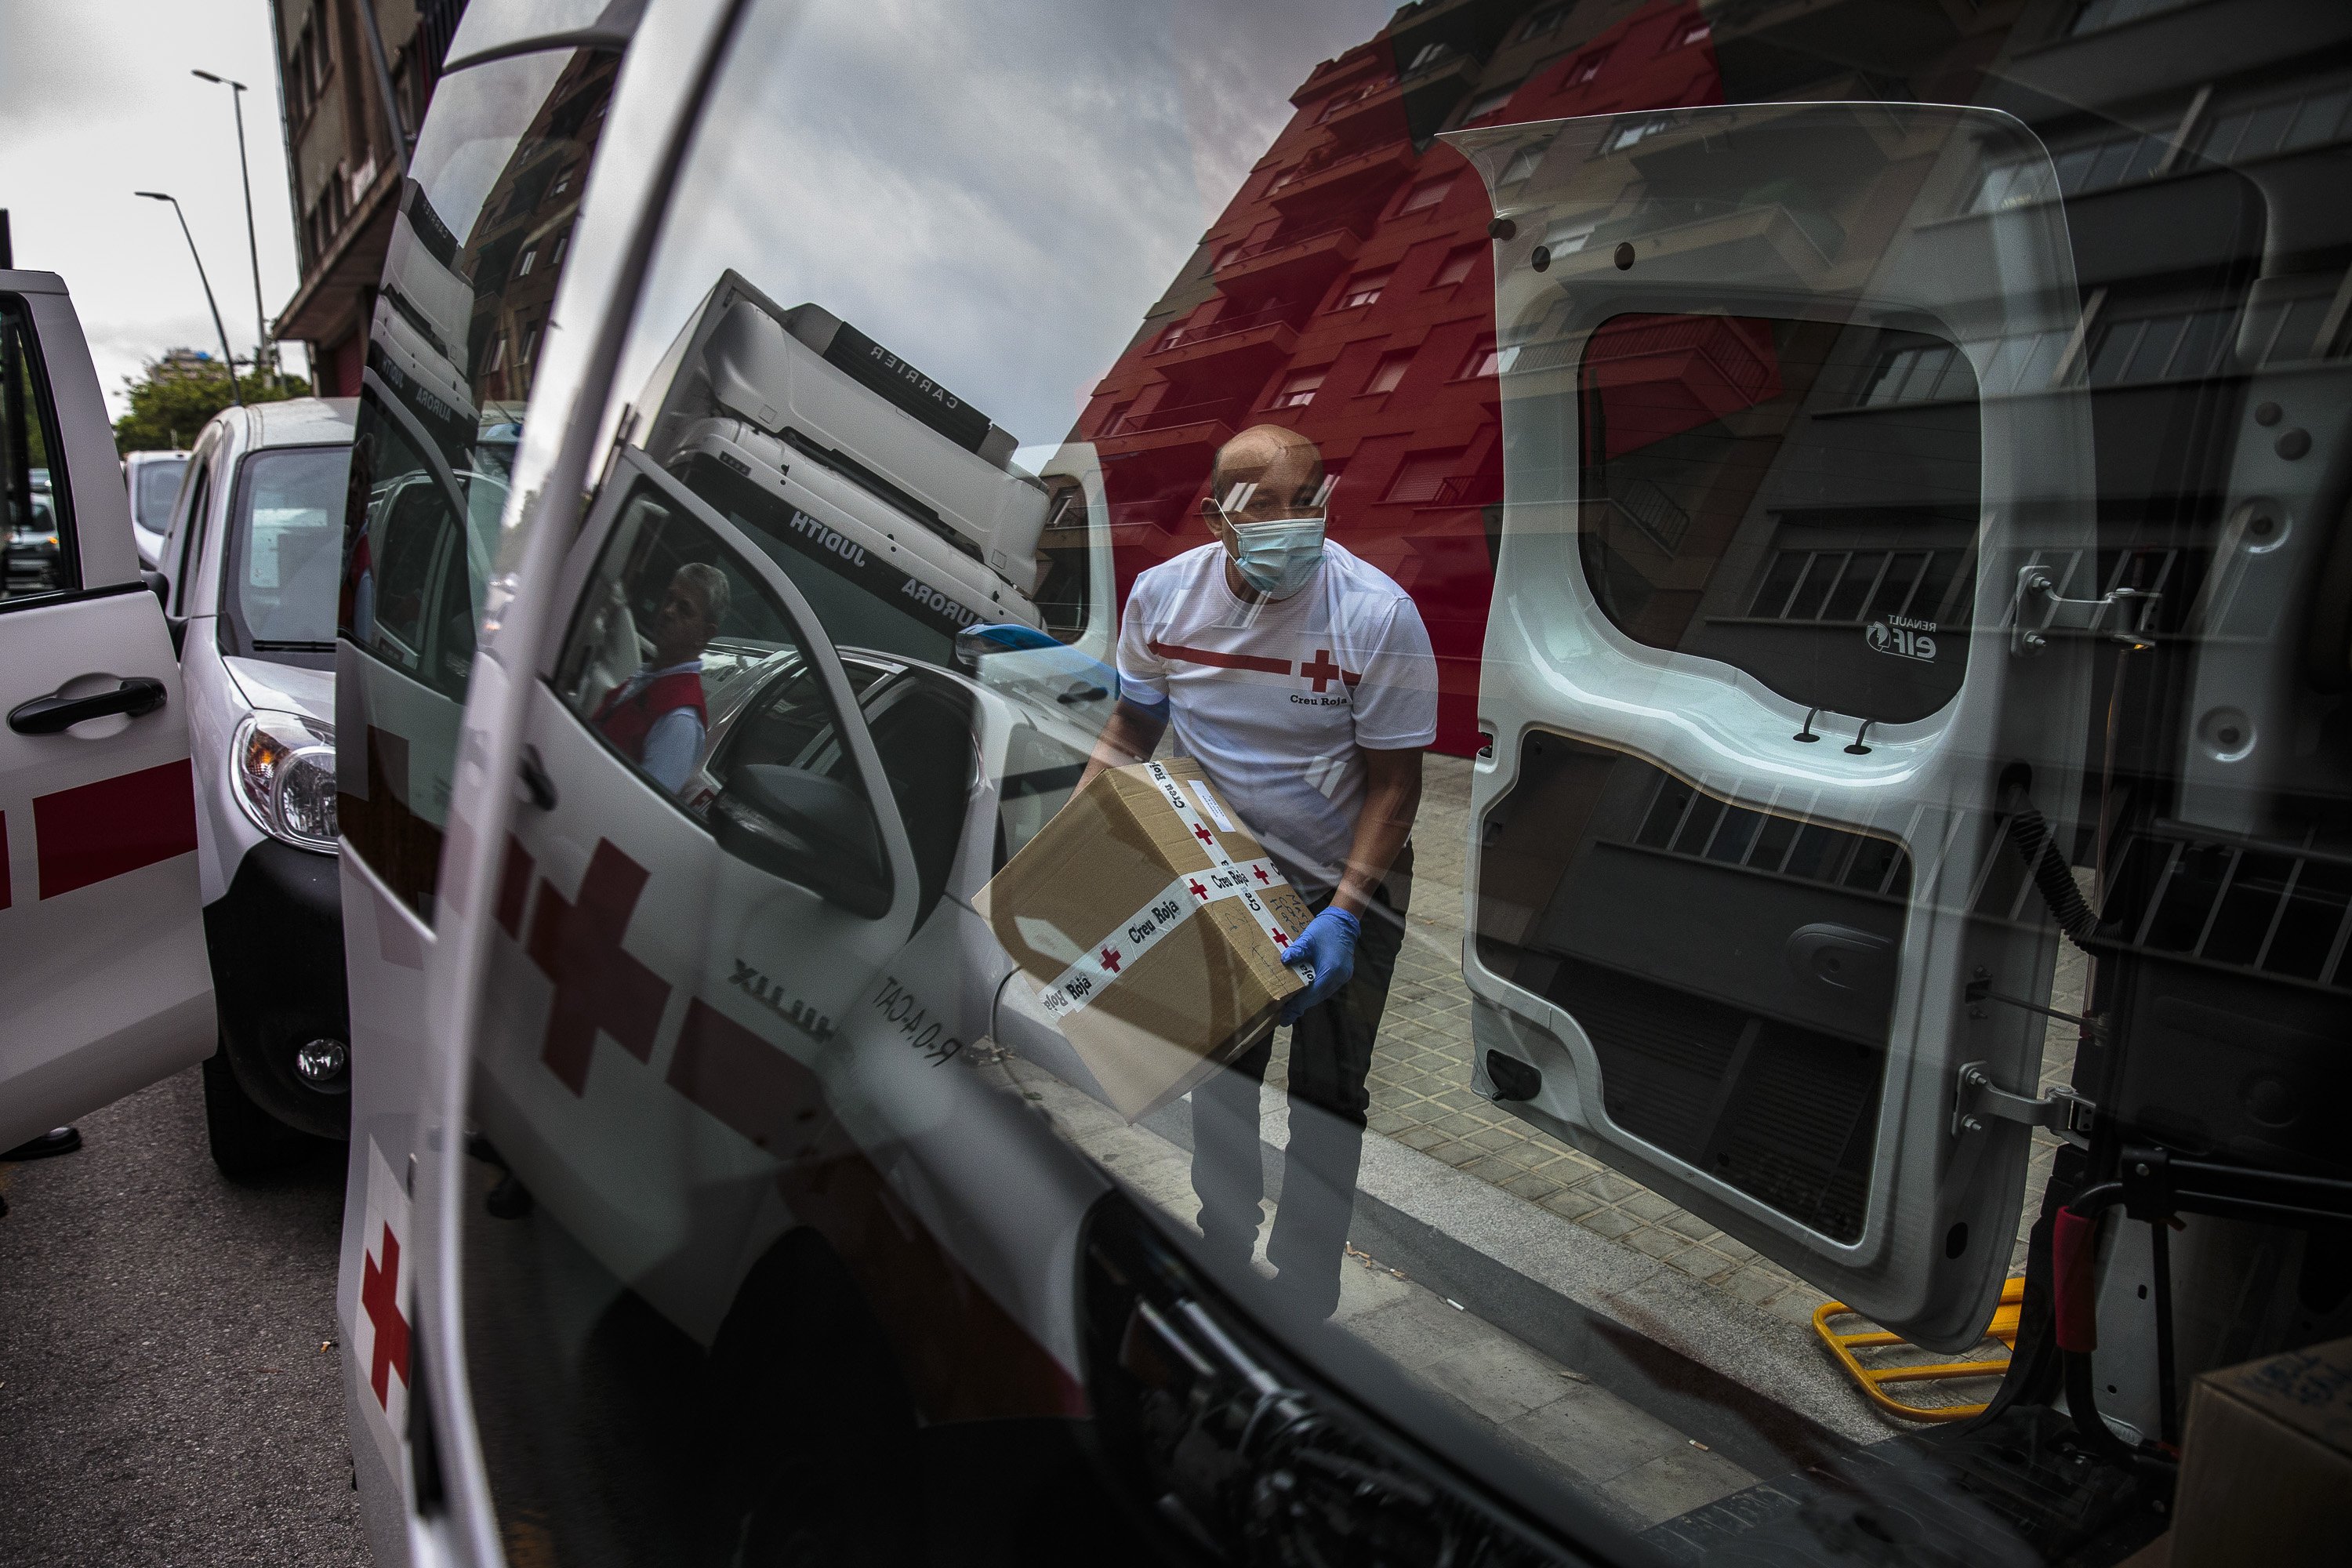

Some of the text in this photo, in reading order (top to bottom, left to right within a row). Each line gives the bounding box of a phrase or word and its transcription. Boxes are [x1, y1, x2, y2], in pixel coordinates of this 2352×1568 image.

[1290, 695, 1348, 706] Creu Roja
[1149, 760, 1187, 809] Creu Roj
[1210, 869, 1250, 889] Creu Roja
[1127, 901, 1180, 944] Creu Roja
[1299, 964, 1315, 985] oja
[1065, 977, 1093, 1000] Roja
